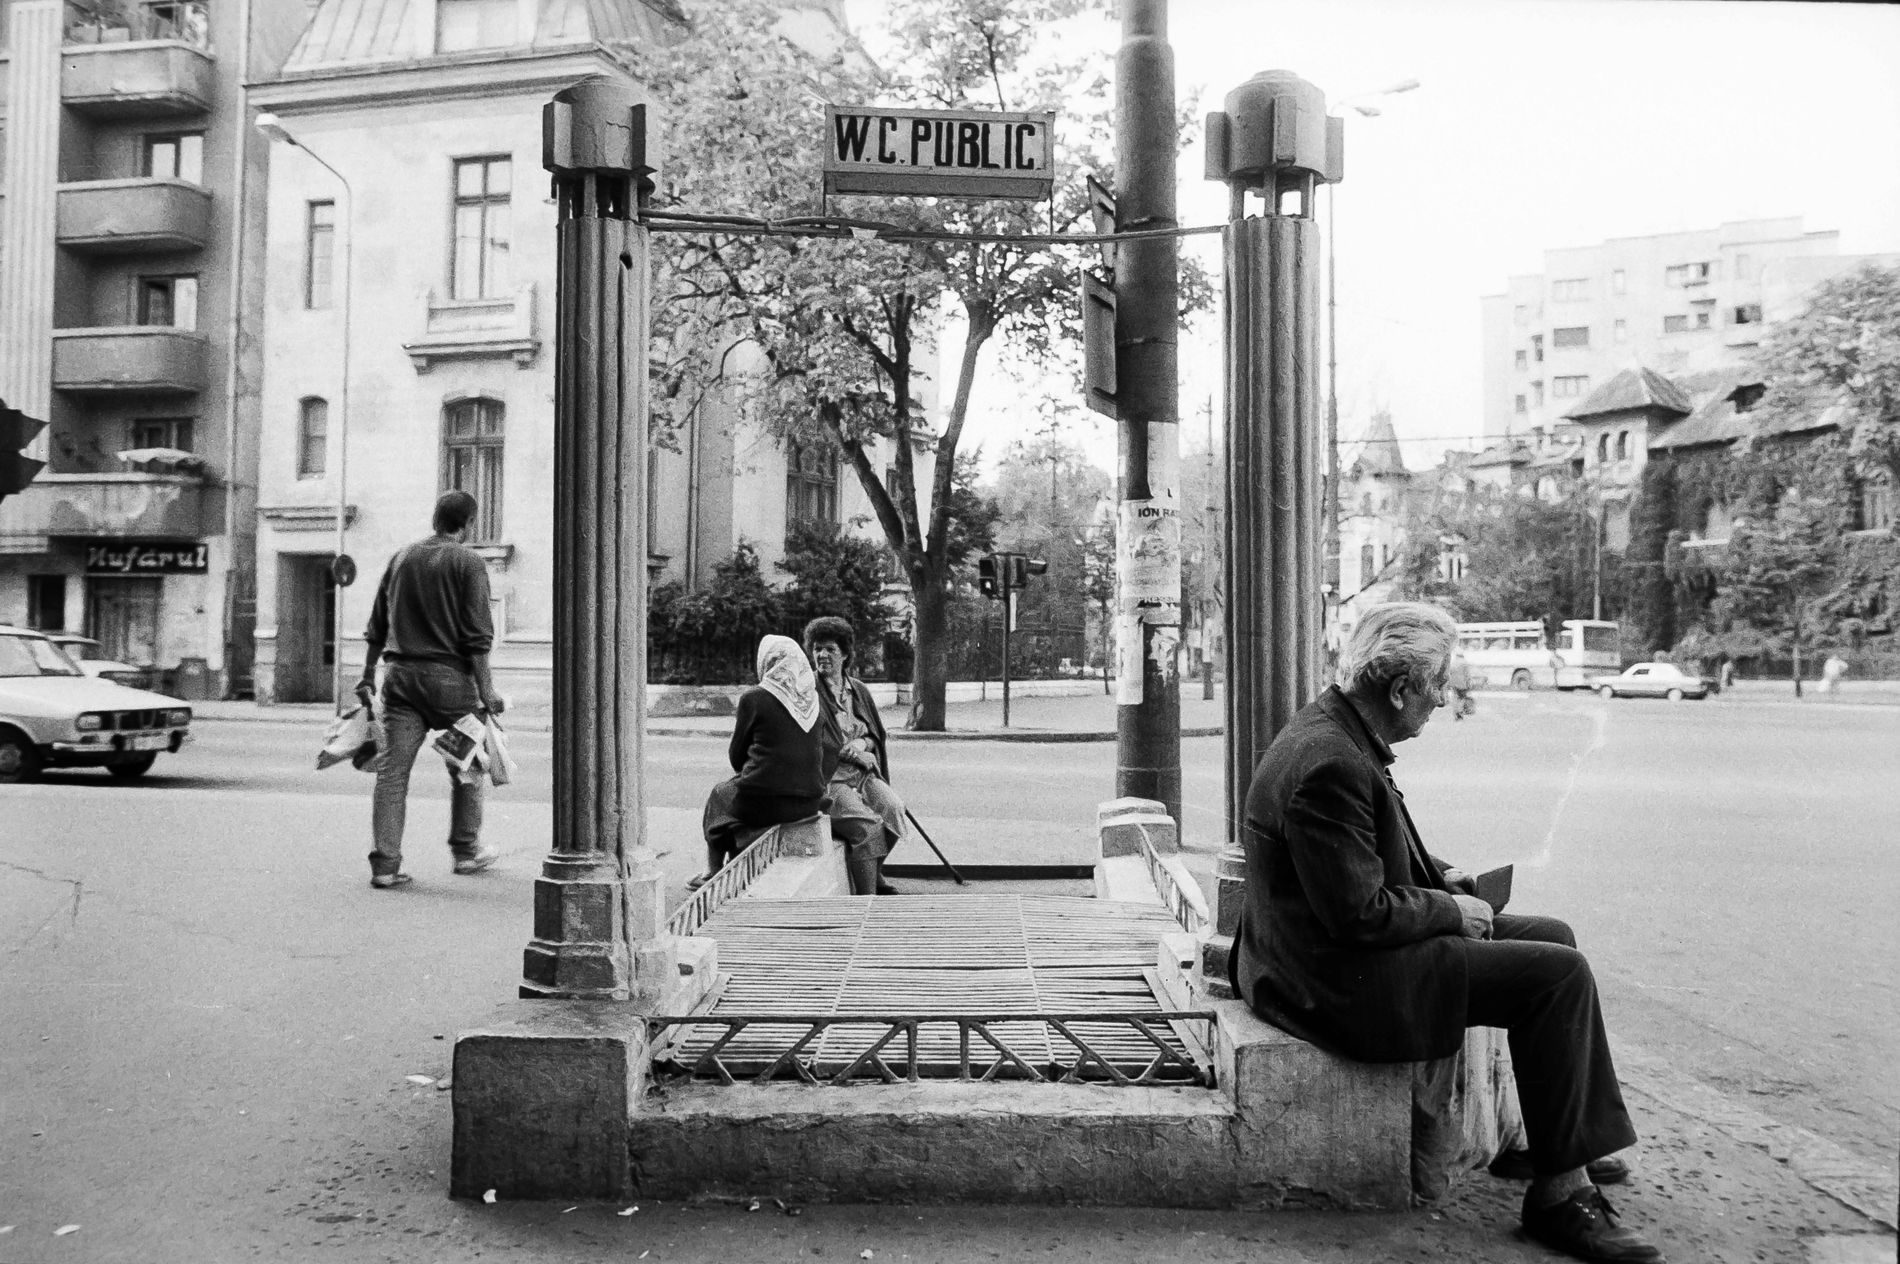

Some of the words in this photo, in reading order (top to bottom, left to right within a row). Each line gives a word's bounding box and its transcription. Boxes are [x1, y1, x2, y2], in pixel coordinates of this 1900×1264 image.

[835, 114, 906, 164] W.C.
[911, 119, 1036, 170] PUBLIC
[1138, 508, 1160, 518] ION
